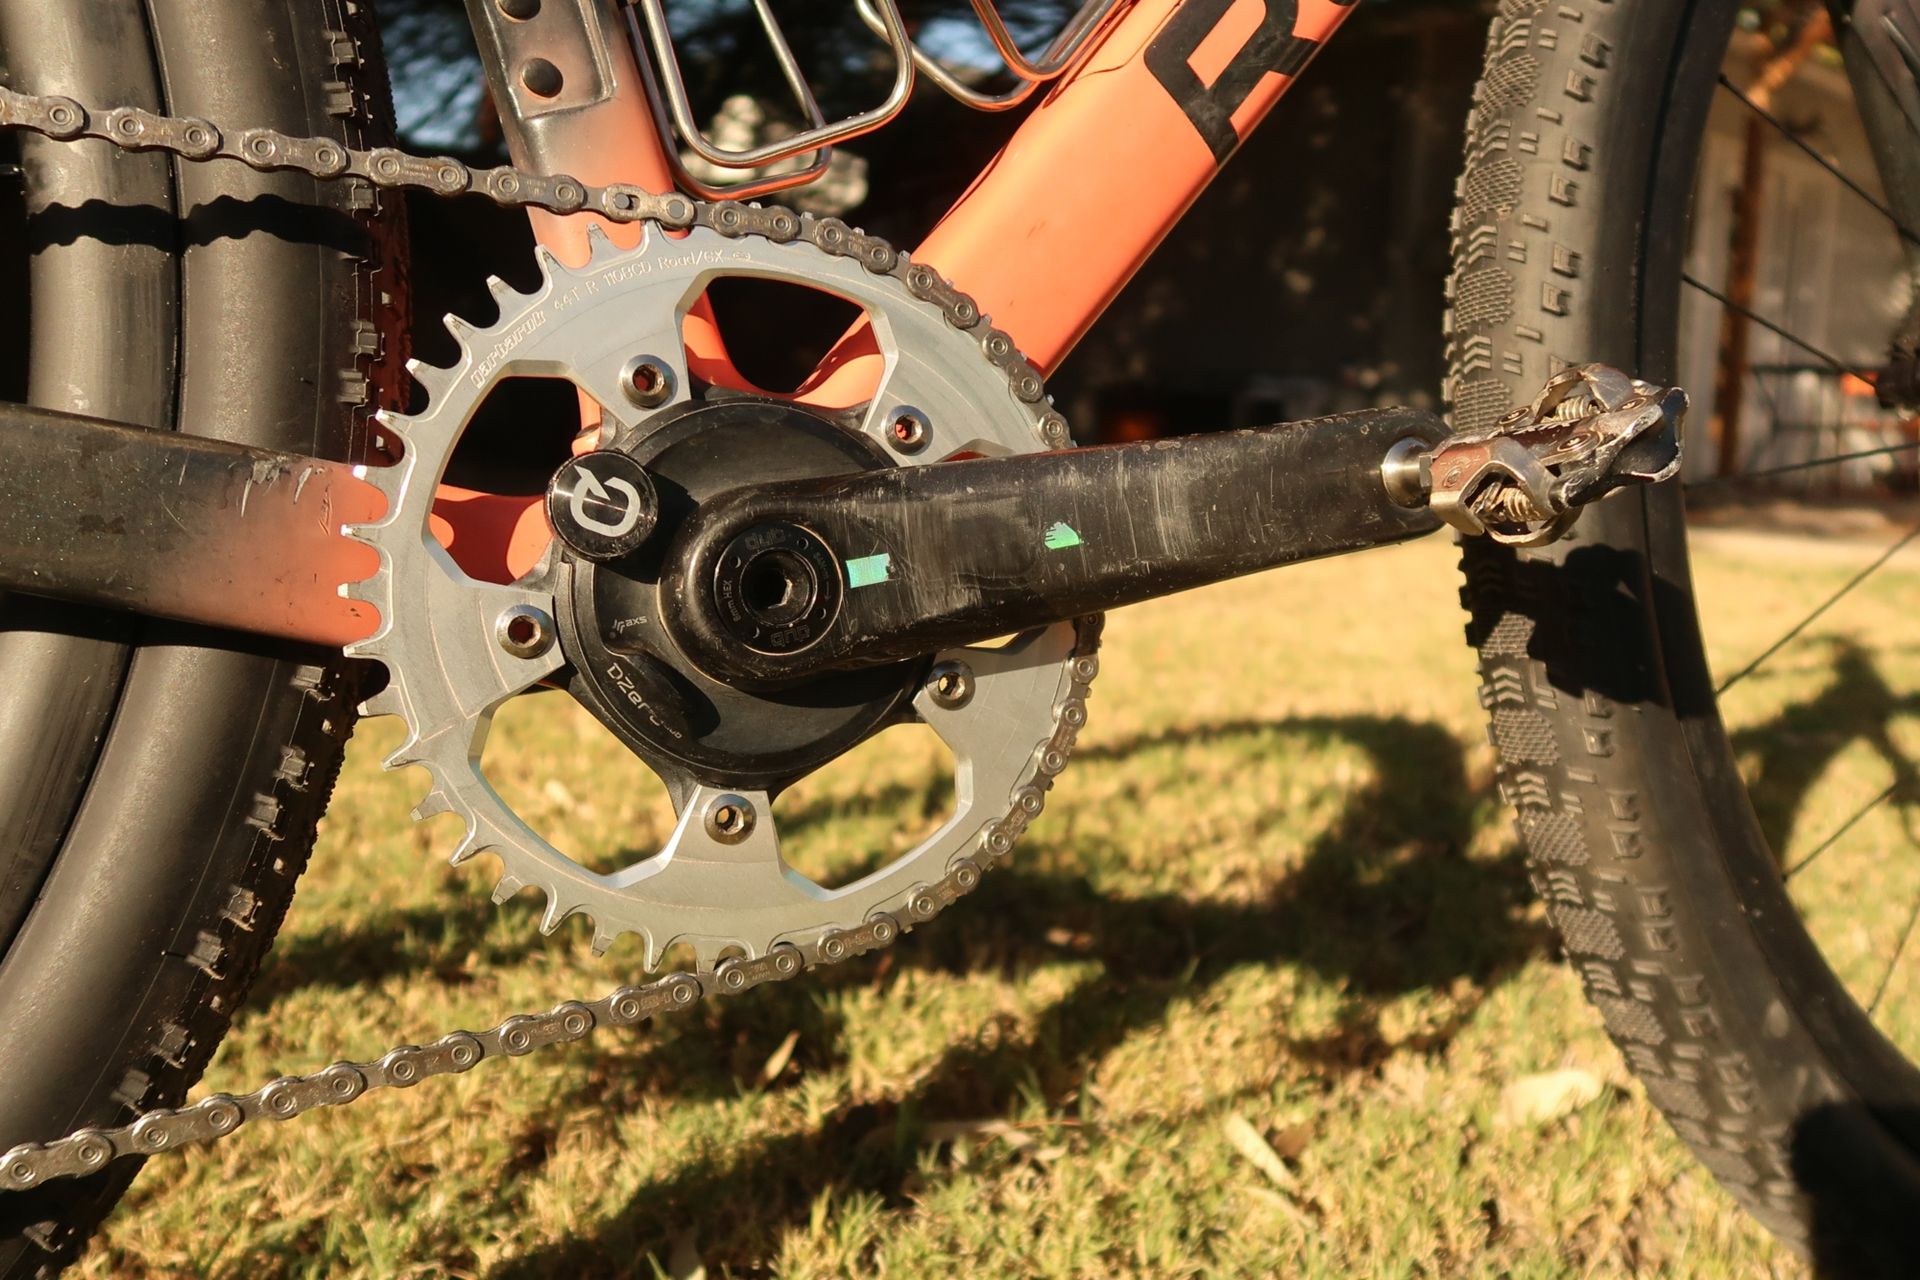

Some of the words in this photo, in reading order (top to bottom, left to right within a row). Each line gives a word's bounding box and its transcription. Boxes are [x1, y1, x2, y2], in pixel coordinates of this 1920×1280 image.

[586, 280, 600, 295] R
[722, 579, 734, 600] HEX
[625, 616, 648, 628] axs
